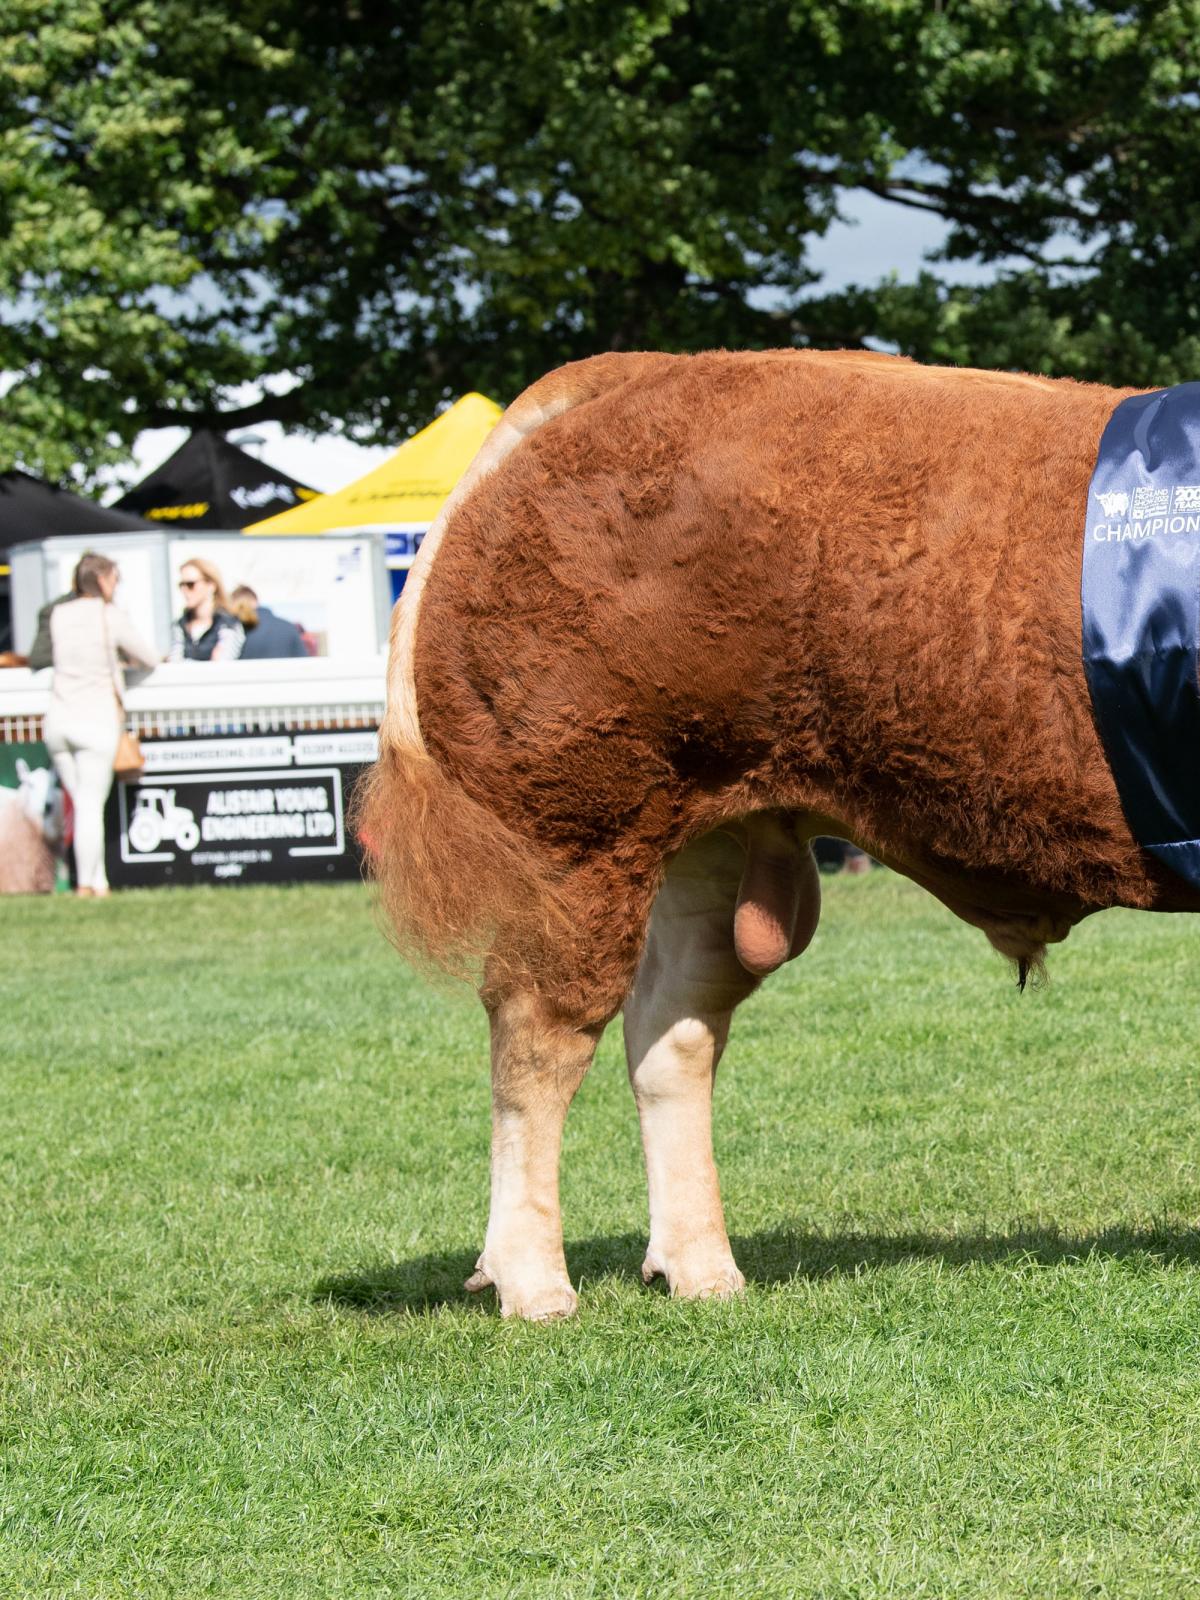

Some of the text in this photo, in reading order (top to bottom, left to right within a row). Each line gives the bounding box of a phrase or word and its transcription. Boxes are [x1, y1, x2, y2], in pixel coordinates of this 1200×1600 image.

[1093, 516, 1200, 542] CHAMPION
[206, 787, 328, 815] ALISTAIR YOUNG
[201, 811, 335, 841] ENGINEERING LTD
